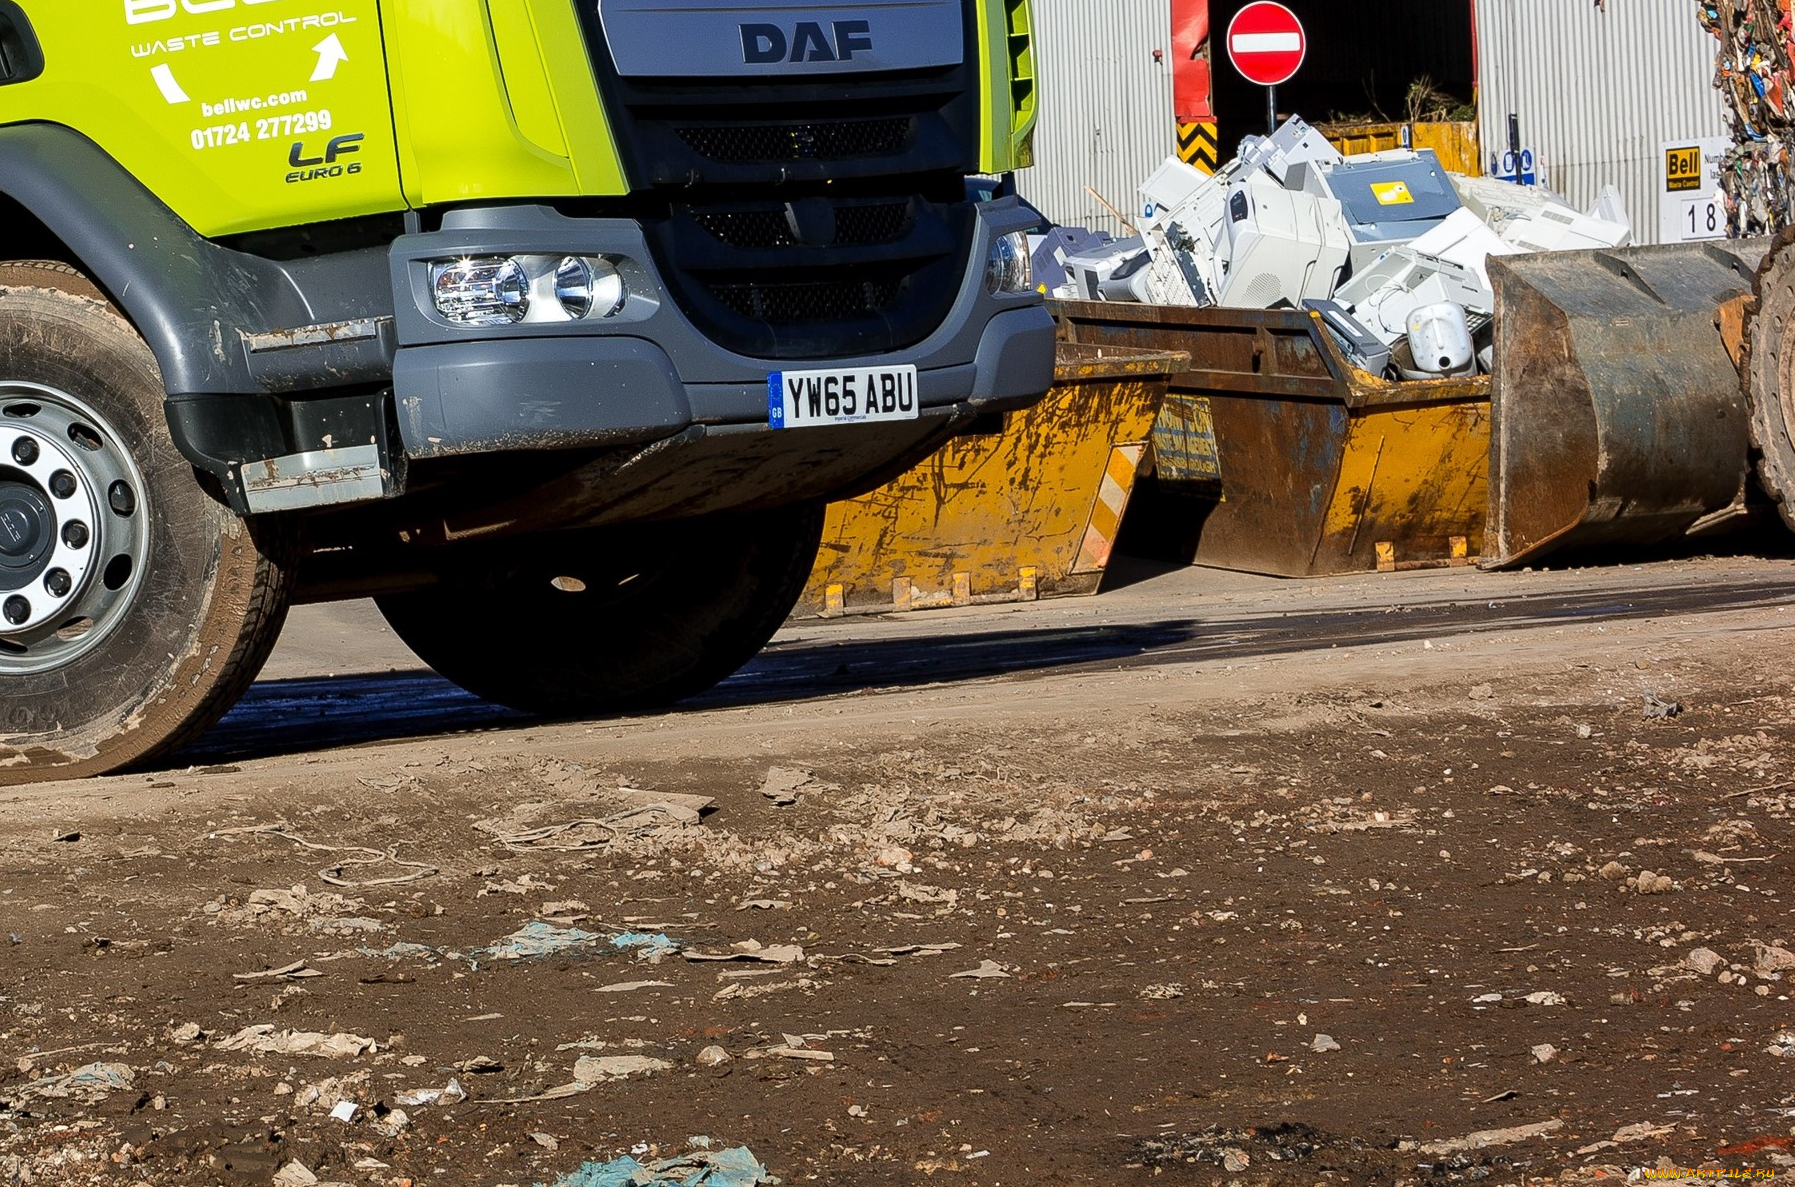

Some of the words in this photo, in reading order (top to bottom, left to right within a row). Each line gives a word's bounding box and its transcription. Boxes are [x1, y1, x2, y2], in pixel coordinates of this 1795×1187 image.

[130, 31, 221, 58] WASTE
[228, 11, 357, 42] CONTROL
[737, 19, 874, 64] DAF
[201, 89, 308, 118] bellwc.com
[190, 122, 251, 150] 01724
[256, 109, 332, 140] 277299
[288, 133, 365, 167] LF
[1668, 151, 1698, 175] Bell
[285, 165, 343, 184] EURO
[347, 162, 362, 176] 6
[772, 407, 783, 418] GB
[788, 375, 857, 419] YW65
[865, 372, 913, 414] ABU
